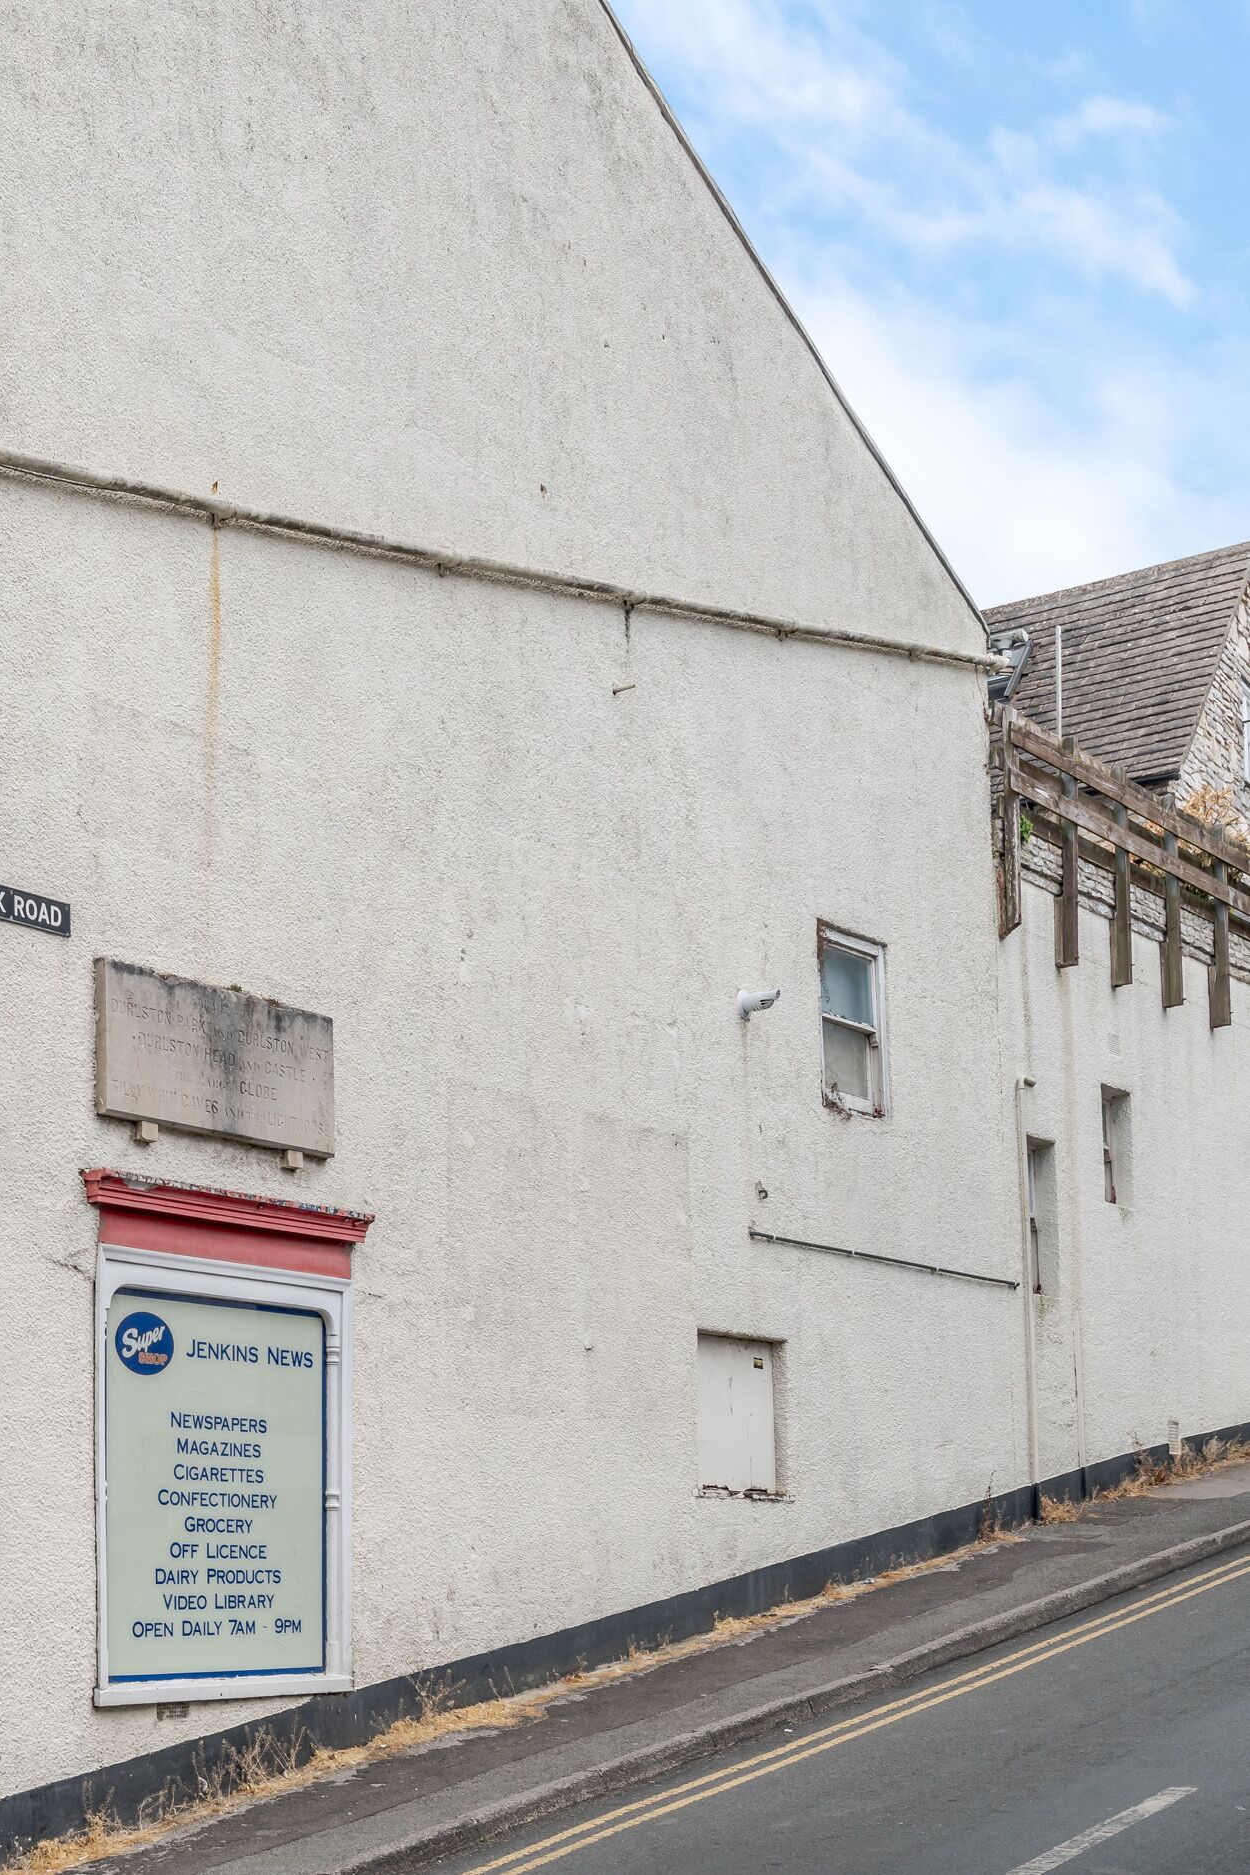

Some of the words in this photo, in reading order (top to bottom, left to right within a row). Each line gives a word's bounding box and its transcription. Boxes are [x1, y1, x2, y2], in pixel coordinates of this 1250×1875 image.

[13, 894, 62, 927] ROAD
[238, 1029, 294, 1055] DURLSTON
[204, 1047, 236, 1067] HEAD
[239, 1080, 278, 1102] GLOBE
[121, 1325, 166, 1359] Super
[138, 1353, 169, 1366] SHOP
[186, 1339, 259, 1364] JENKINS
[267, 1346, 314, 1369] NEWS
[170, 1411, 268, 1434] NEWSPAPERS
[176, 1438, 262, 1458] MAGAZINES
[173, 1463, 264, 1484] CIGARETTES
[157, 1489, 278, 1509] CONFECTIONERY
[184, 1516, 253, 1534] GROCERY
[170, 1542, 199, 1559] OFF
[206, 1543, 267, 1560] LICENCE
[155, 1568, 199, 1585] DAIRY
[206, 1568, 281, 1584] PRODUCTS
[163, 1593, 207, 1610] VIDEO
[214, 1593, 275, 1610] LIBRARY
[132, 1621, 174, 1638] OPEN
[182, 1620, 223, 1637] DAILY
[228, 1619, 256, 1636] 7AM
[274, 1618, 302, 1634] 9PM
